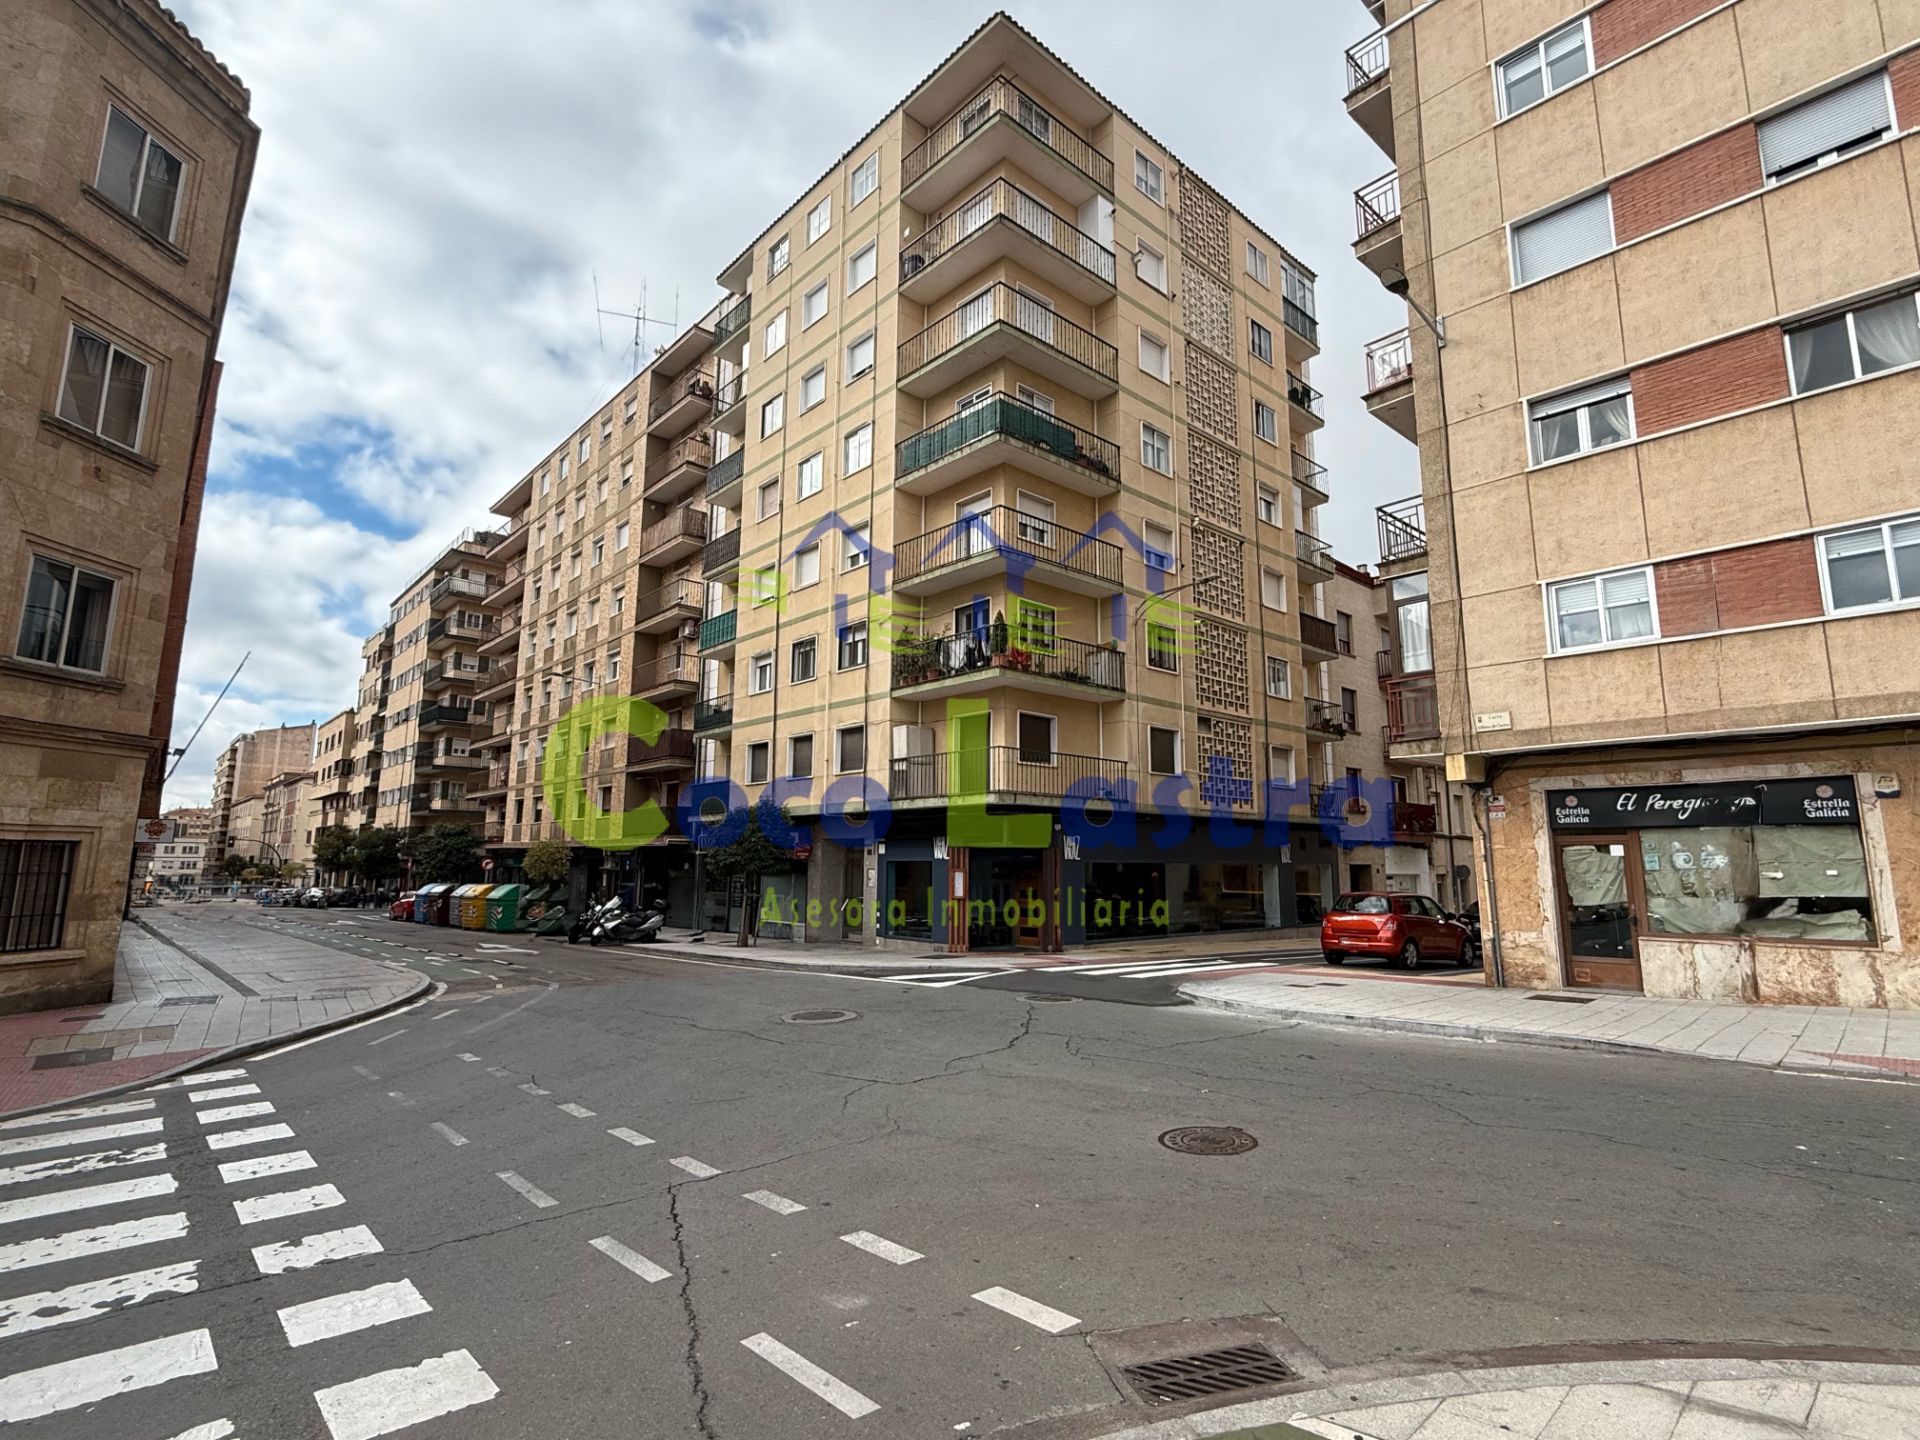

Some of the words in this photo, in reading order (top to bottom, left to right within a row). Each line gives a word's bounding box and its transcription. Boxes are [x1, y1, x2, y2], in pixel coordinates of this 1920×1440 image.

[1616, 793, 1638, 811] El
[1803, 798, 1850, 809] Estrella
[1555, 807, 1590, 816] Estrella
[1805, 808, 1850, 818] Galicia
[1557, 815, 1590, 824] Galicia
